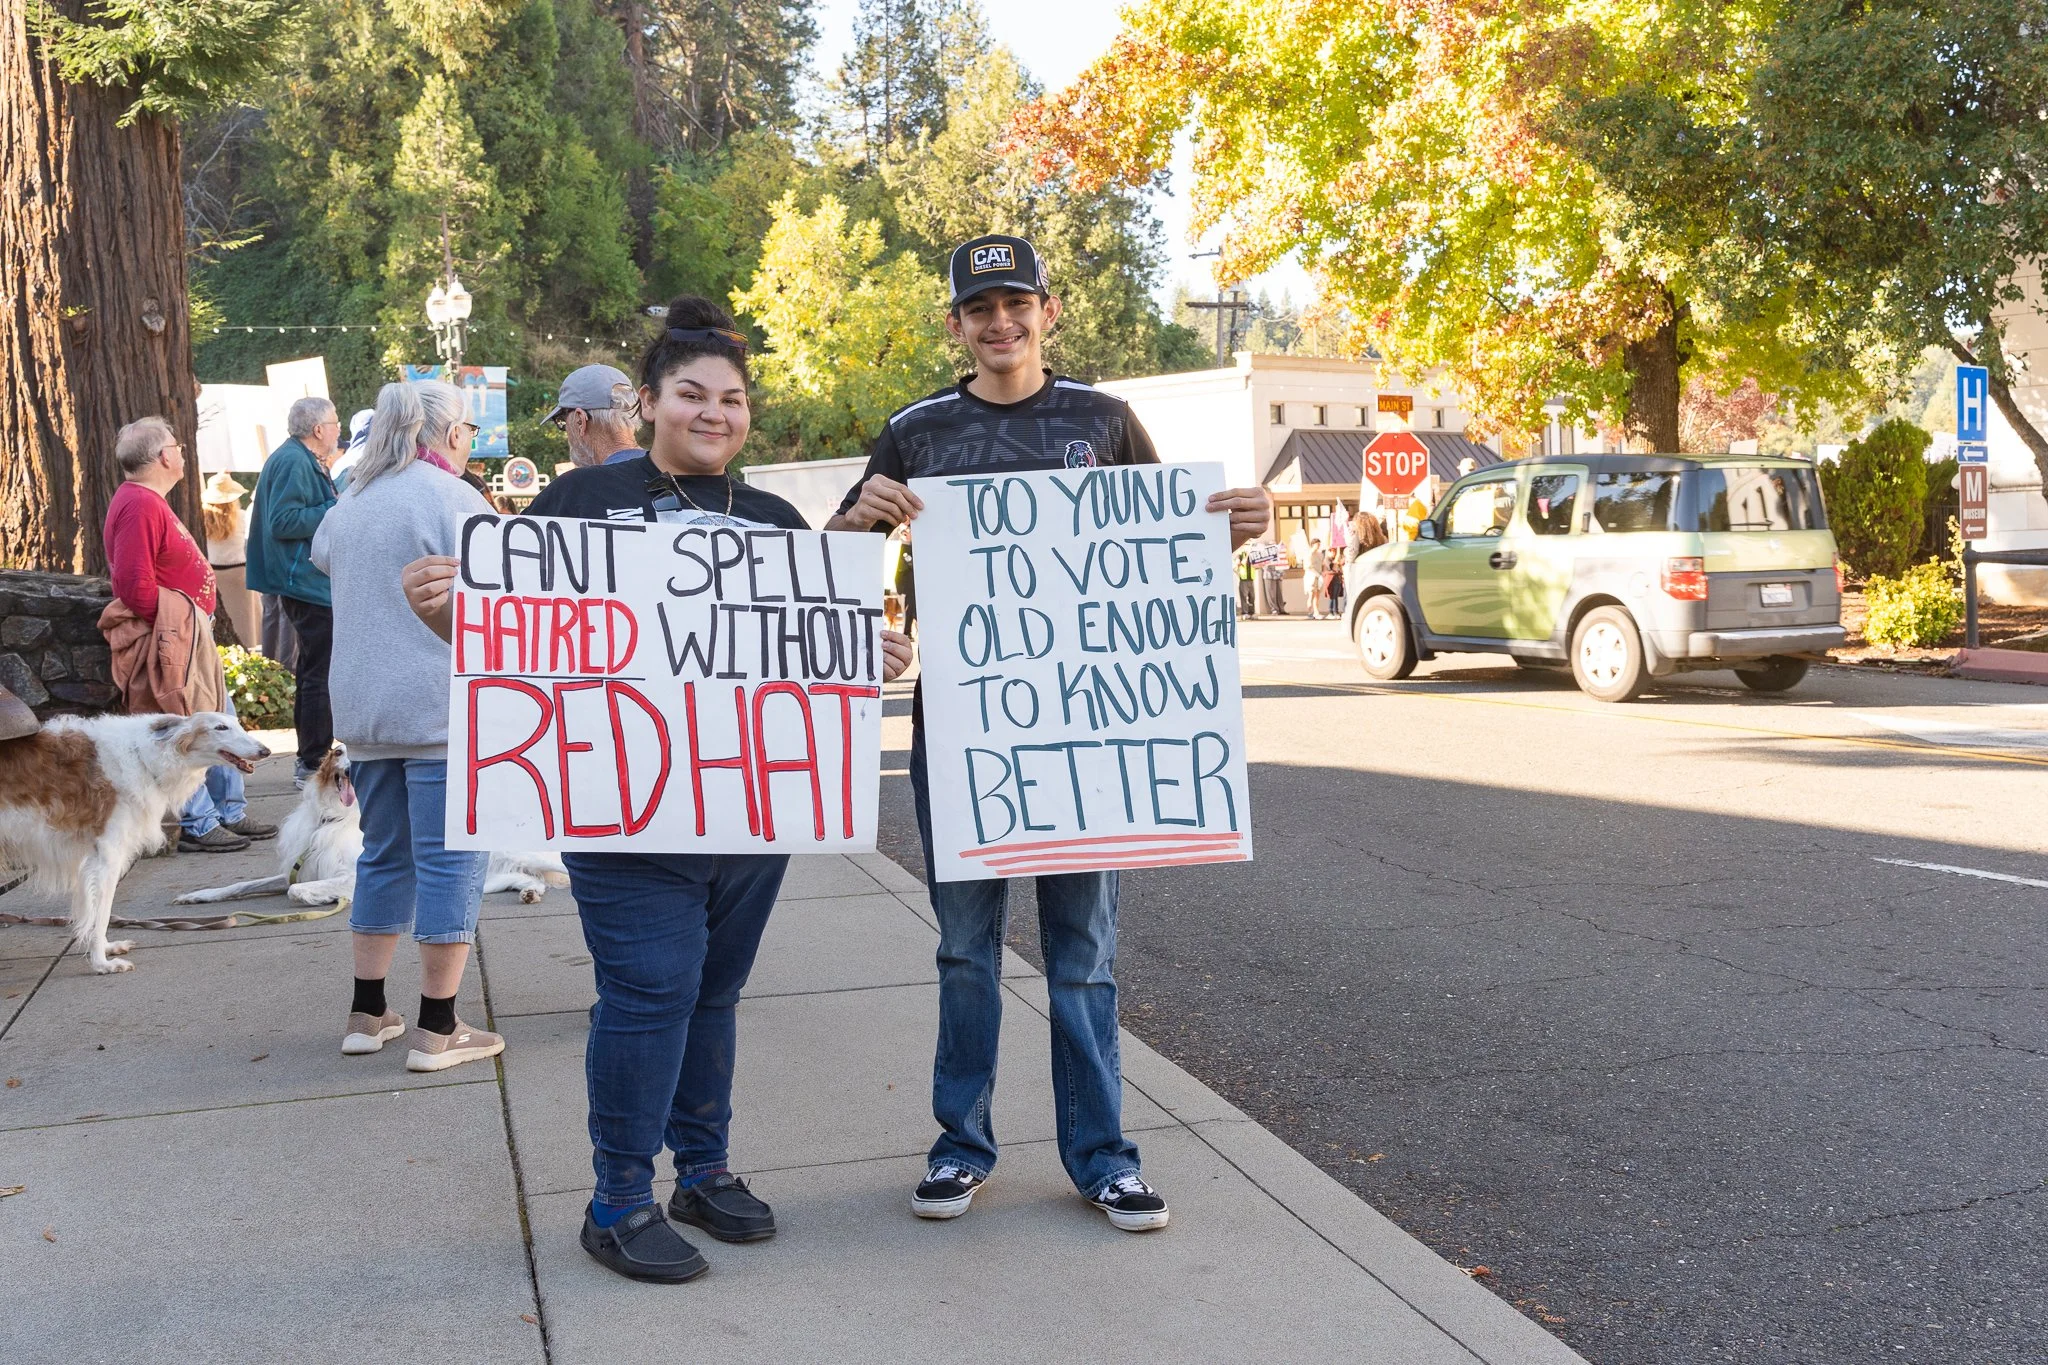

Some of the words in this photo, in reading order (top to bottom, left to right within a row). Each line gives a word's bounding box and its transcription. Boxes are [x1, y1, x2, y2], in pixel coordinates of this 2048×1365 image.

[975, 263, 992, 271] DIESEL
[1380, 400, 1399, 411] MAIN
[1401, 401, 1411, 412] ST
[1963, 377, 1982, 431] H
[1367, 451, 1426, 477] STOP
[1966, 471, 1982, 502] M
[946, 477, 1037, 540] TOO
[1050, 468, 1197, 537] YOUNG
[1963, 508, 1986, 520] MUSEUM
[460, 514, 647, 594] CANT
[667, 527, 862, 606] SPELL
[969, 543, 1037, 599] TO
[1051, 533, 1214, 596] VOTE,
[456, 592, 639, 674] HATRED
[657, 602, 883, 681] WITHOUT
[958, 603, 1055, 667] OLD
[1078, 593, 1236, 656] ENOUGH
[958, 675, 1040, 734] TO
[1057, 654, 1220, 731] KNOW
[467, 678, 672, 841] RED
[684, 681, 880, 842] HAT
[965, 731, 1238, 845] BETTER
